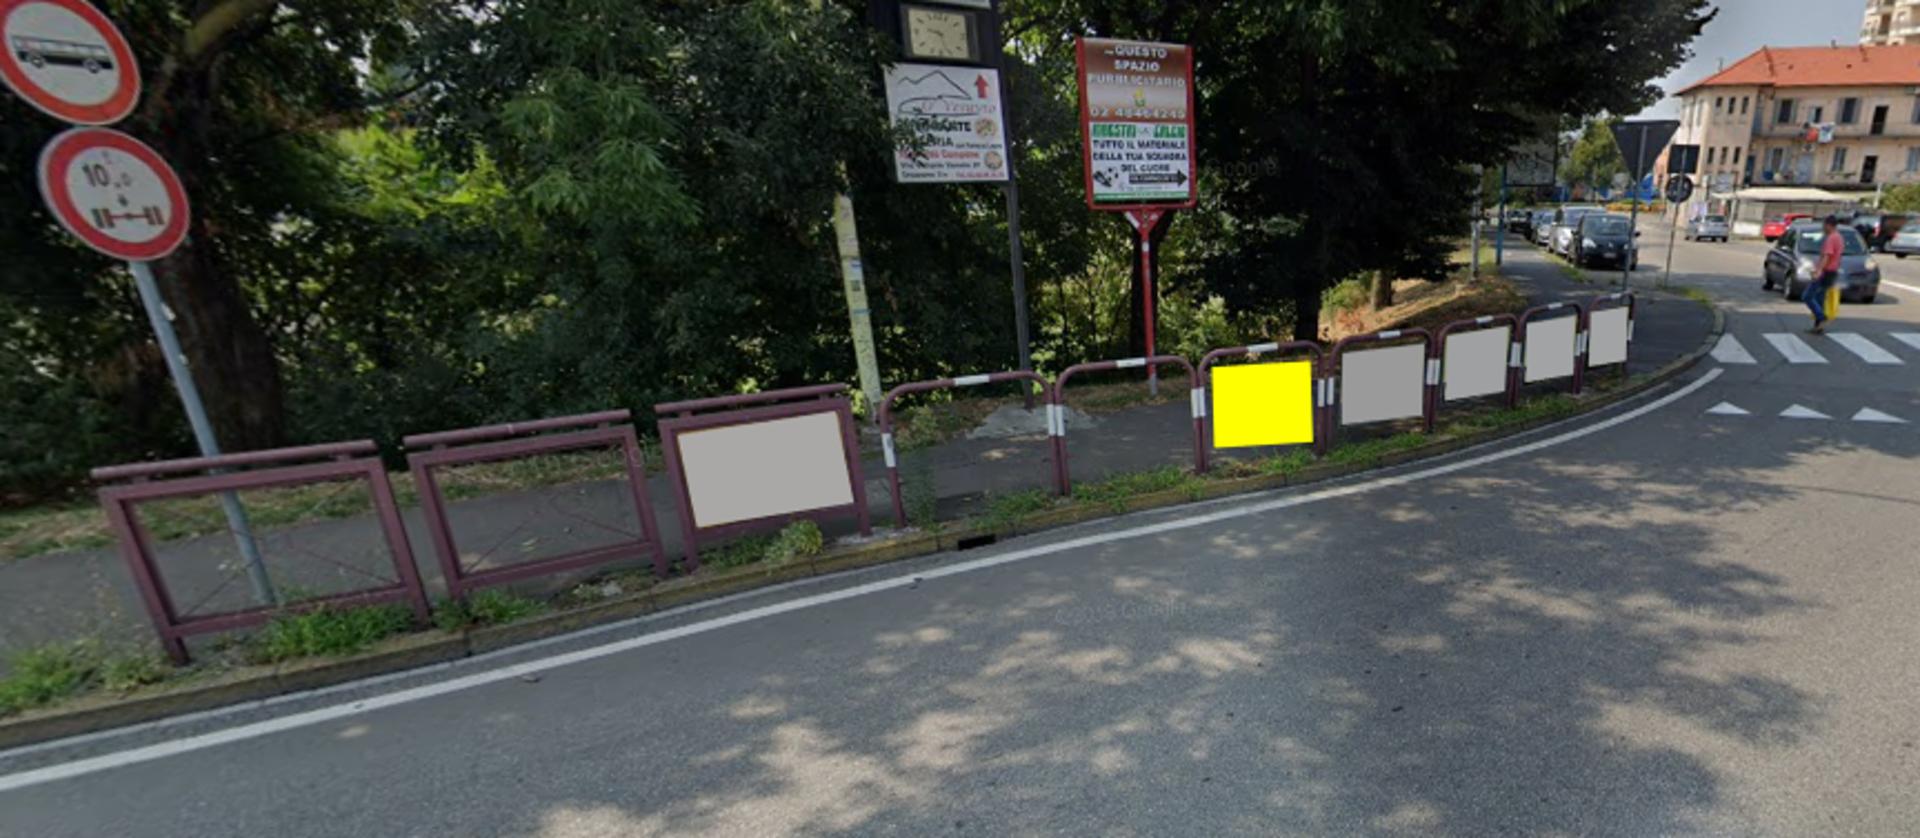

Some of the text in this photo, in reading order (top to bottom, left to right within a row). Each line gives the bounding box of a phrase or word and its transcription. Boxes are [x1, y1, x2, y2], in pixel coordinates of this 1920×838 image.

[1114, 61, 1160, 72] SPAZIO
[1088, 74, 1186, 88] PUBBLICITARIO
[1090, 108, 1109, 118] 02
[1093, 140, 1186, 149] TUTTO IL MATERIALE
[1093, 152, 1187, 161] DELLA TUA SQUADRA
[1121, 164, 1170, 172] DEL CUORE
